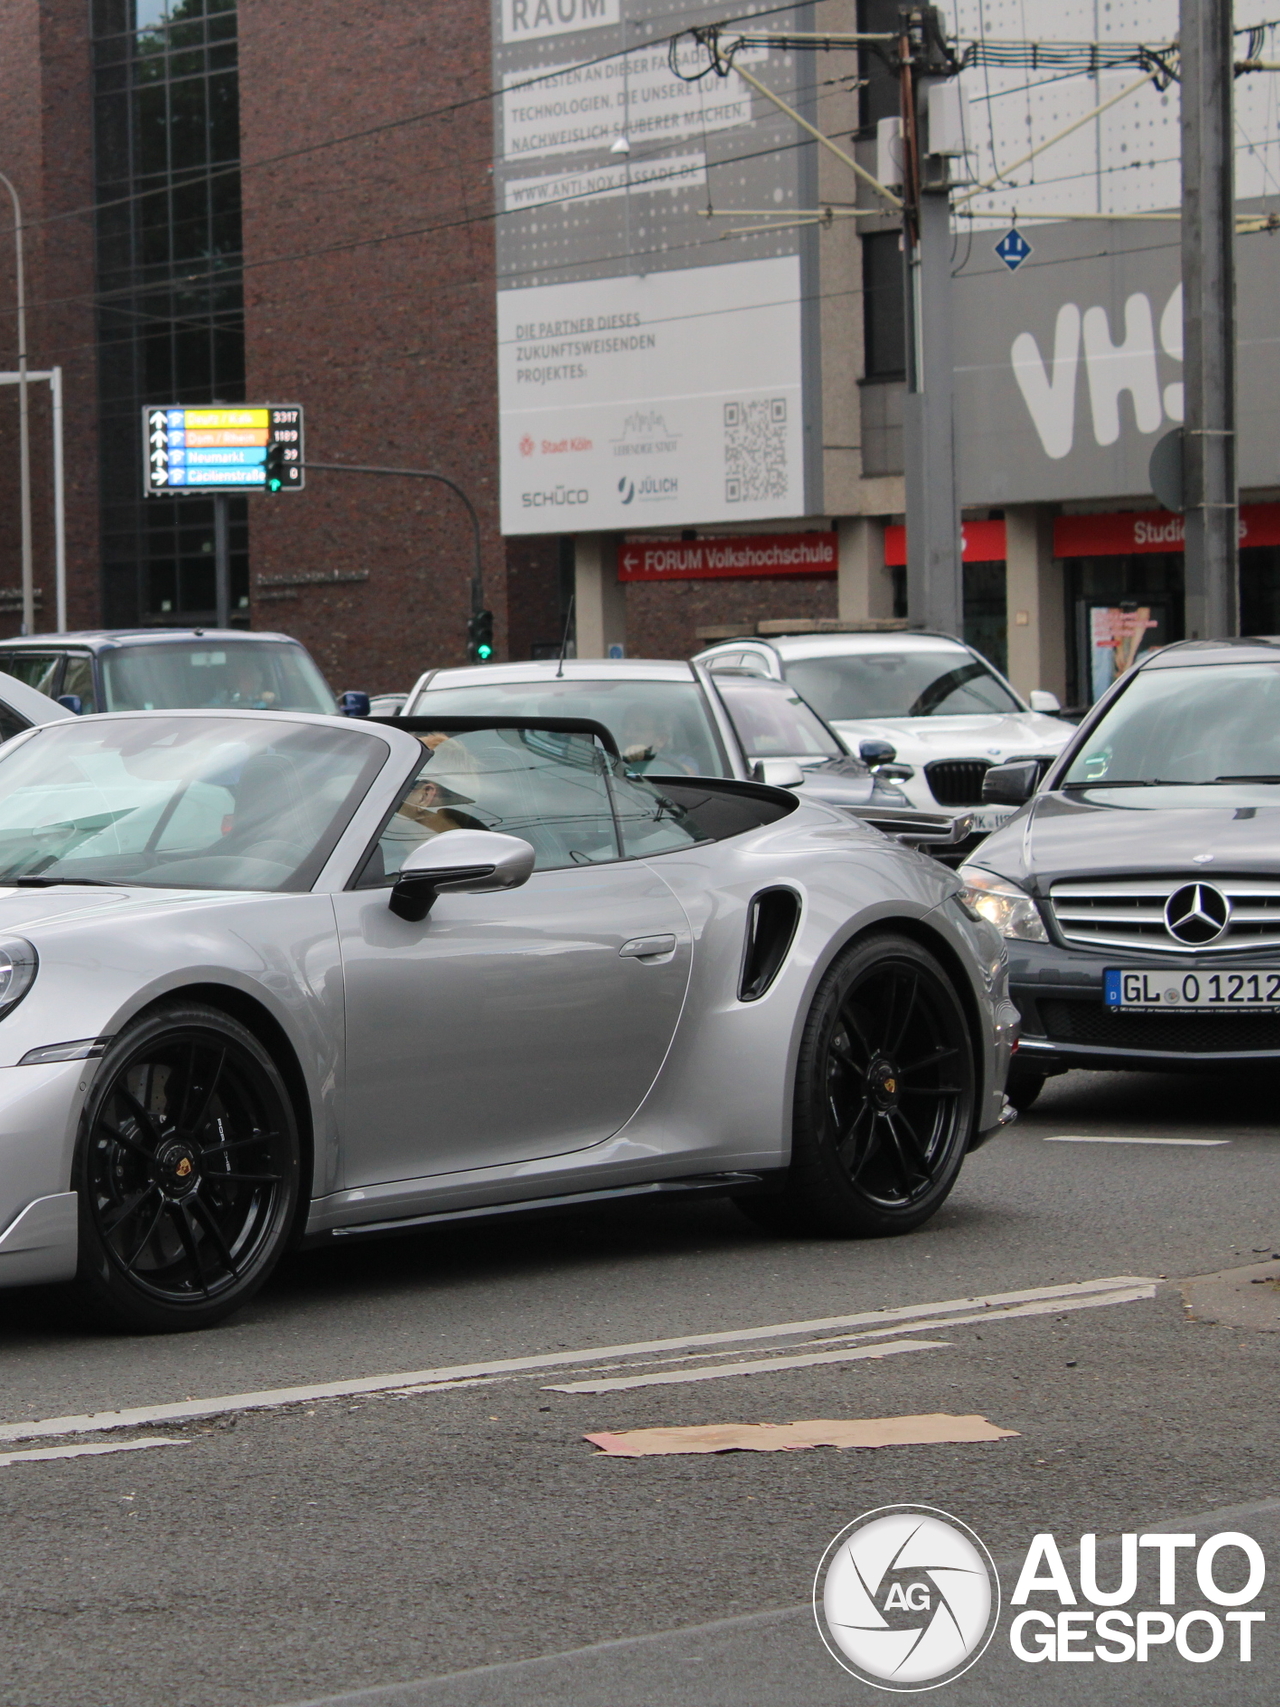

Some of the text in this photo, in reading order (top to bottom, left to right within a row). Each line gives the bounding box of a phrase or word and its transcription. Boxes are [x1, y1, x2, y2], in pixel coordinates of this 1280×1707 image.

[511, 0, 606, 31] RAUM
[539, 69, 582, 88] TESTEN
[585, 66, 602, 80] AN
[606, 57, 648, 79] DIESER
[617, 89, 638, 107] DIE
[642, 80, 692, 103] UNSERE
[698, 77, 729, 94] LUFT
[511, 103, 747, 152] NACHWEISLICH SAUBERER MACHEN.
[515, 312, 641, 339] DIE PARTNER DIESES
[515, 334, 656, 361] ZUKUNFTSWEISENDEN
[516, 363, 588, 385] PROJEKTES:
[188, 412, 219, 425] Deutz
[228, 411, 253, 424] Kalk
[273, 411, 298, 424] 3317
[188, 431, 215, 444] Dom
[223, 431, 255, 444] Rhein
[541, 436, 593, 454] Stadt Köln
[613, 440, 678, 457] LEBENDIGE STADT
[188, 451, 245, 464] Neumarkt
[188, 468, 266, 483] Cäcilienstraße
[638, 475, 679, 495] JÜLICH
[521, 484, 589, 508] SCHÜCO
[644, 541, 834, 572] FORUM Volkshochschule
[1123, 974, 1161, 1003] GL
[1208, 974, 1280, 1003] 1212
